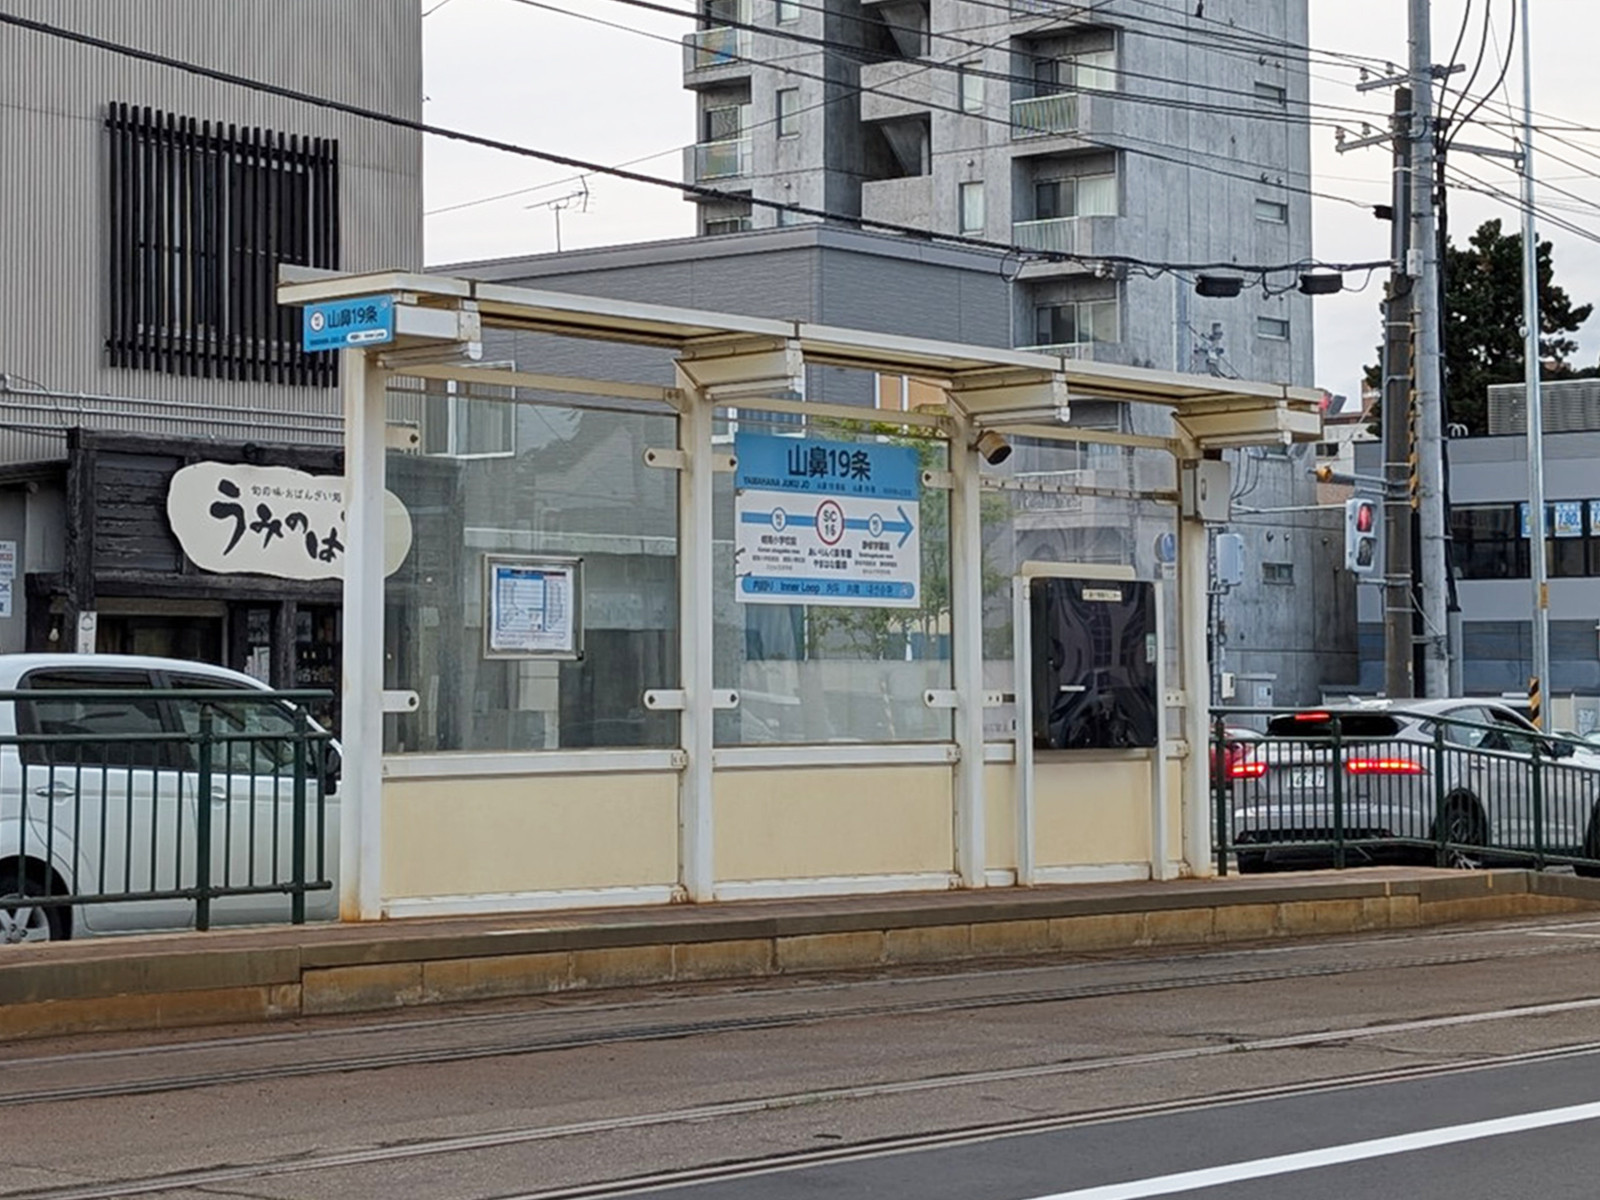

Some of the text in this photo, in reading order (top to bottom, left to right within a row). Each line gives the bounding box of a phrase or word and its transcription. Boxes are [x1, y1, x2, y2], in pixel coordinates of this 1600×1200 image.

[327, 304, 378, 328] 山鼻19条
[787, 444, 872, 481] 山鼻19条
[823, 509, 837, 523] SC
[801, 581, 821, 594] Loop
